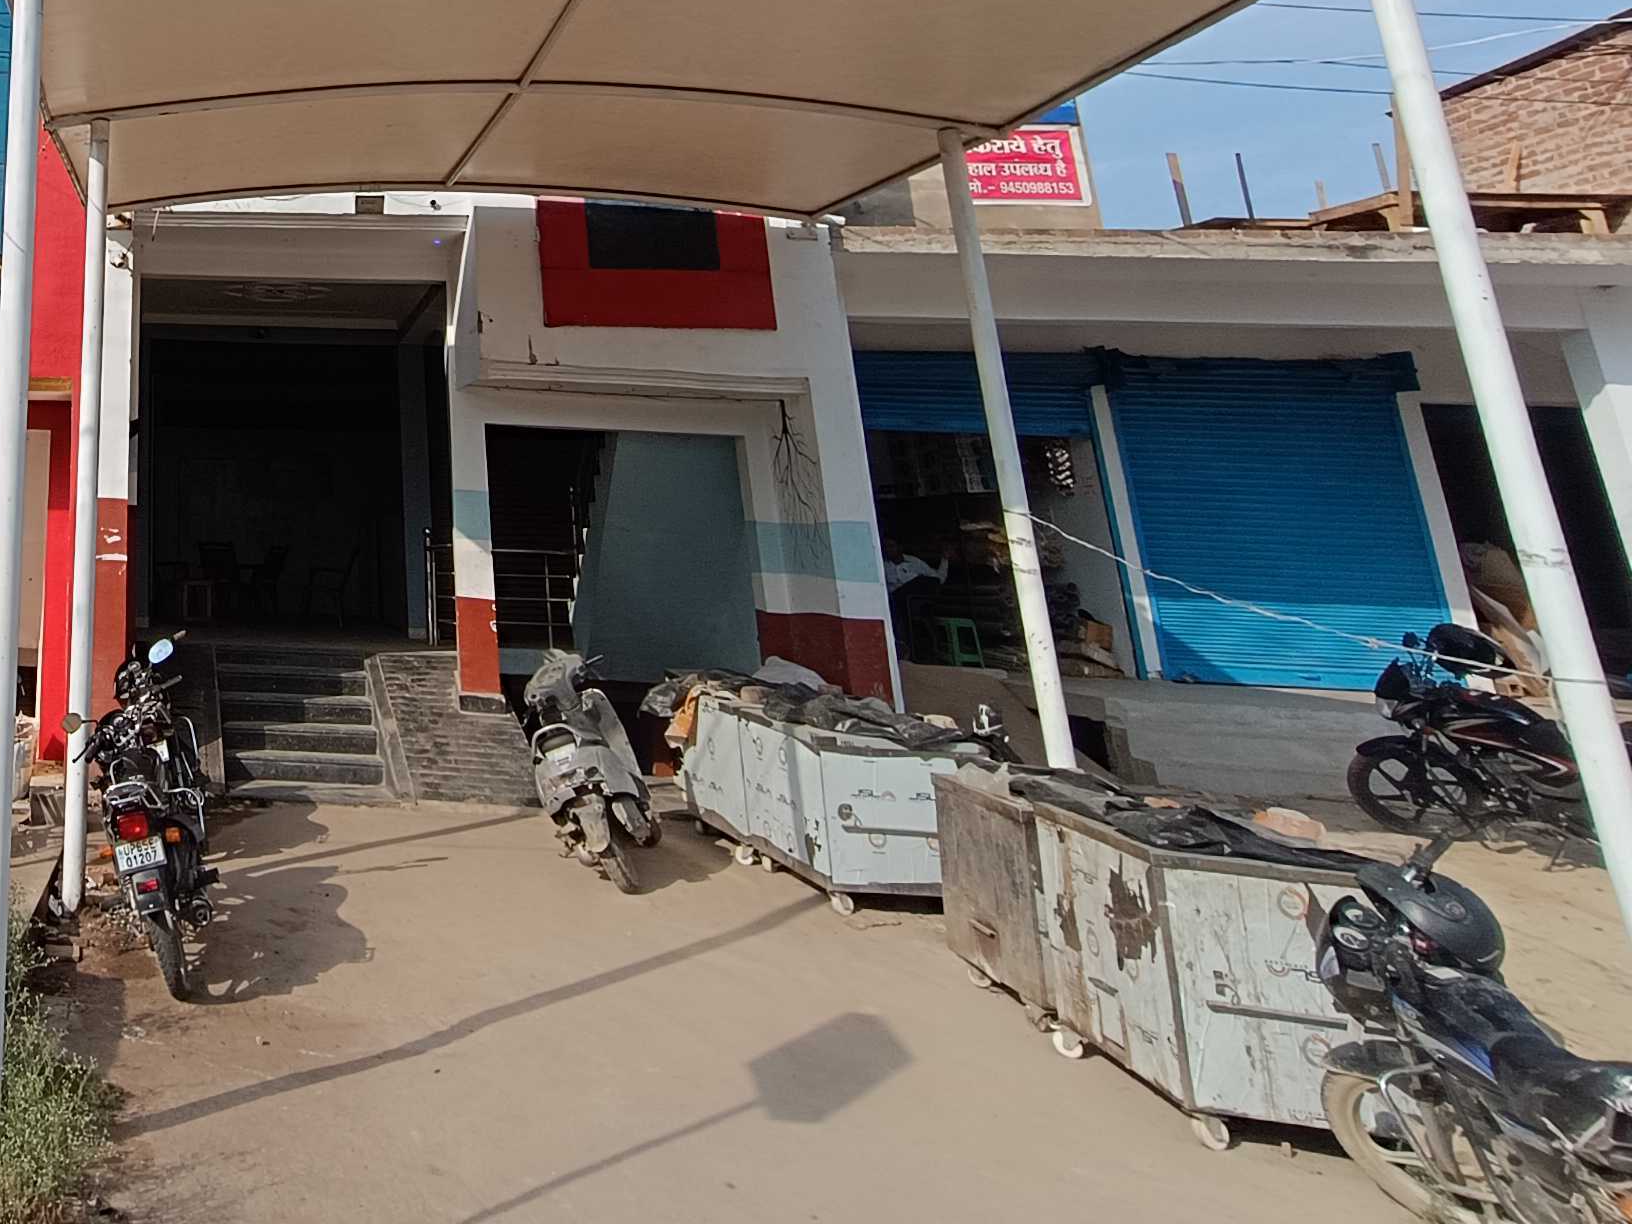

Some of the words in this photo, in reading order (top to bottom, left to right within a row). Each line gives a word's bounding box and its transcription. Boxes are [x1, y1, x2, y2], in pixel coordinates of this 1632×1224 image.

[1030, 135, 1063, 159] हेतु
[1055, 157, 1067, 177] है
[999, 181, 1075, 194] 9450988153
